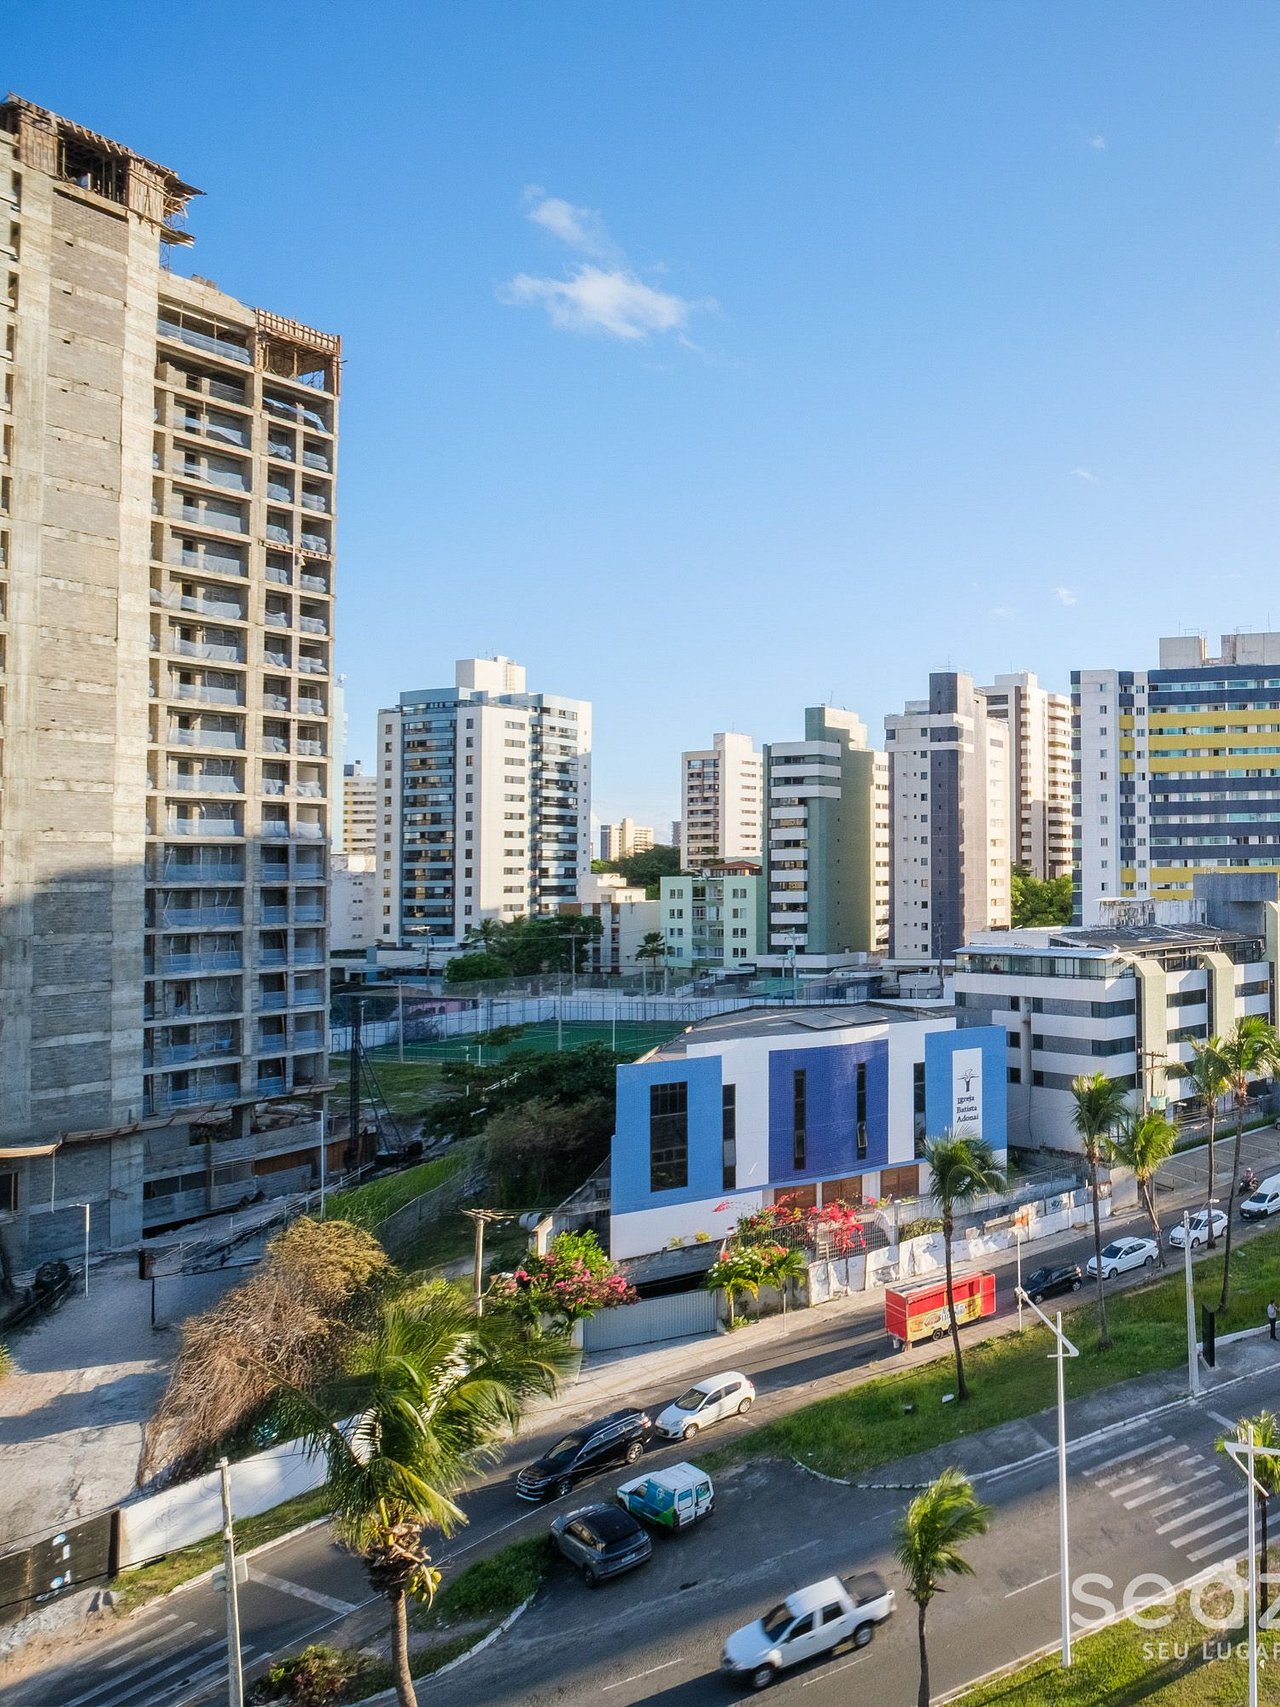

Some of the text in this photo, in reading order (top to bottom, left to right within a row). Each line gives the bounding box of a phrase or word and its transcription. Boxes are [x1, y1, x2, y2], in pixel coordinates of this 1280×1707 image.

[957, 1095, 975, 1104] Igreja
[956, 1106, 978, 1114] Batista
[956, 1113, 979, 1123] Adonai
